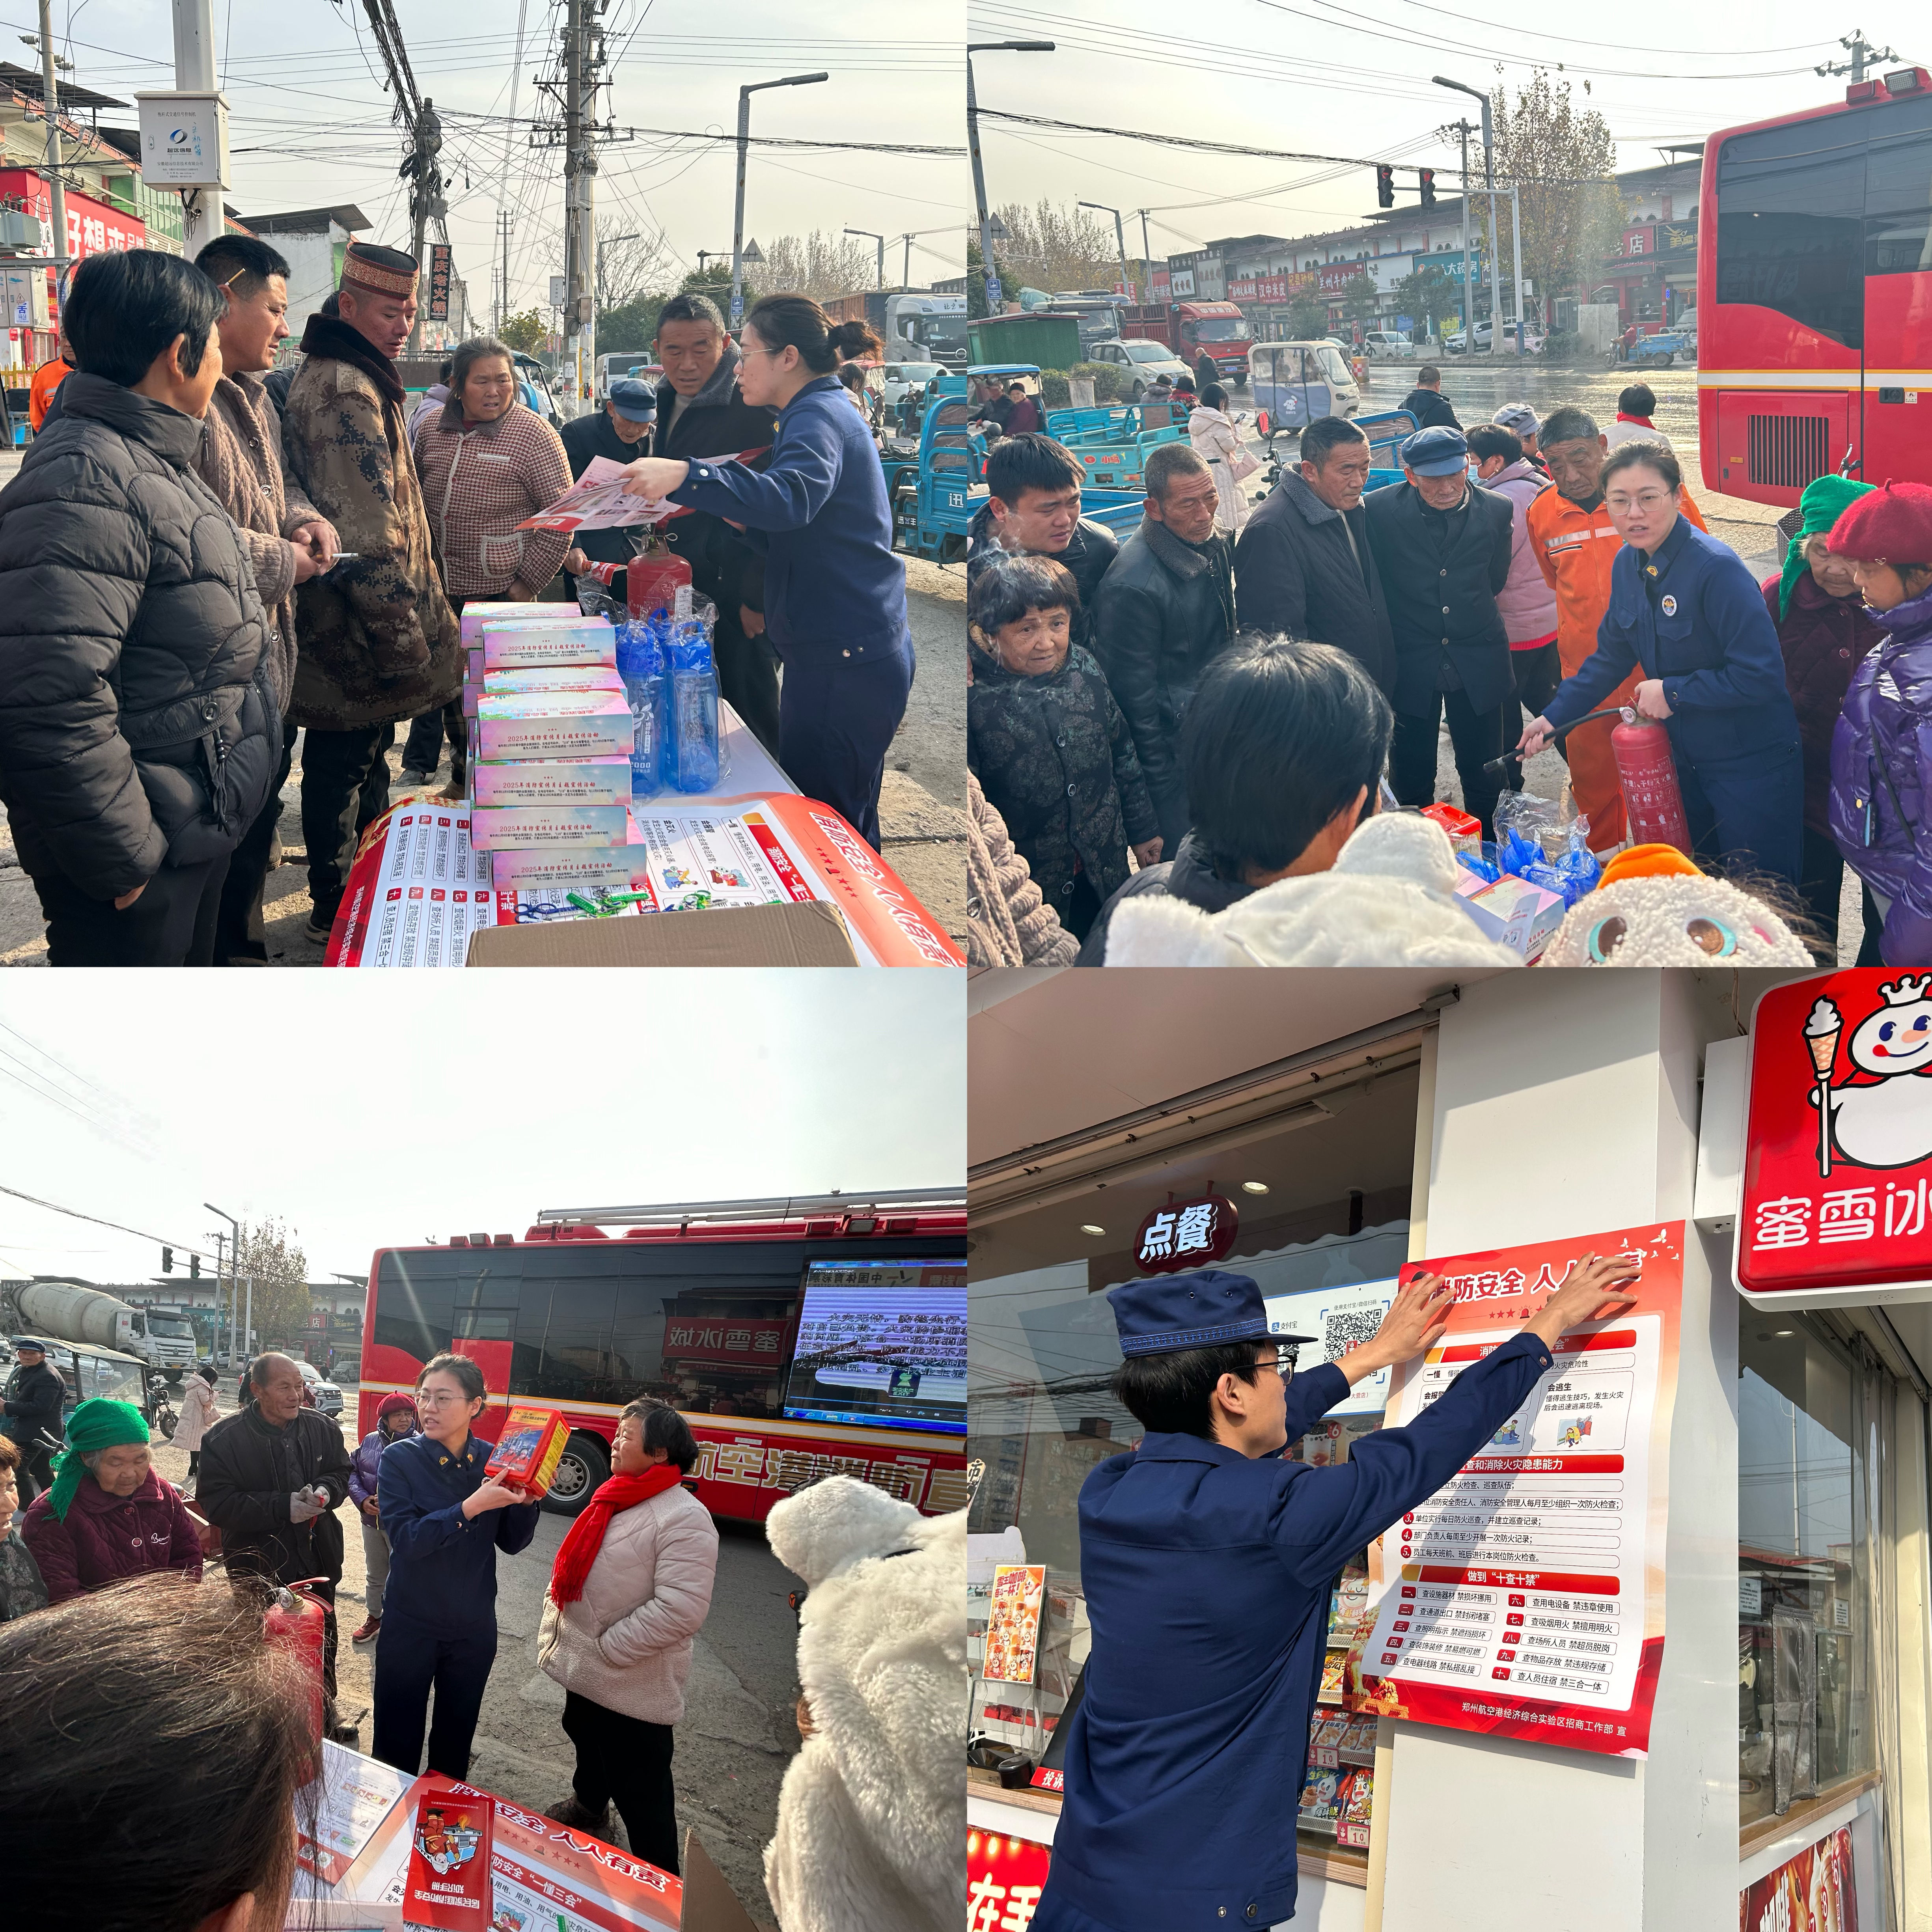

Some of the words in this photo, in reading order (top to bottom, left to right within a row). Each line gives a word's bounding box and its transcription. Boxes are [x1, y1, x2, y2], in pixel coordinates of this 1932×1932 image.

[432, 247, 449, 313] 重庆老火锅
[1259, 281, 1286, 298] 汉中米皮
[949, 492, 964, 508] 迅
[508, 733, 599, 742] 2025年消防宣传月主题宣传活动
[663, 820, 677, 834] 会灭火
[701, 820, 715, 834] 会报警
[396, 829, 409, 852] 查电器线路
[417, 828, 428, 850] 查装饰装修
[438, 830, 447, 852] 查照明指示
[458, 833, 466, 853] 查通道出口
[809, 811, 885, 880] 消防安全
[393, 852, 406, 877] 禁私搭乱接
[414, 851, 426, 875] 禁易燃可燃
[435, 852, 446, 877] 禁遮挡损坏
[456, 855, 466, 879] 禁封闭堵塞
[521, 862, 612, 873] 2025年消防宣传月主题宣传活动
[766, 846, 793, 872] 消防安全
[382, 906, 396, 936] 查人员住宿
[406, 904, 420, 934] 查物品存放
[430, 906, 441, 936] 查场所人员
[453, 908, 464, 936] 查吸烟用火
[1139, 1203, 1213, 1260] 点餐
[1333, 1299, 1377, 1311] 使用支付宝/微信扫码
[1280, 1321, 1298, 1330] 支付宝
[1427, 1370, 1441, 1378] 一懂
[1548, 1382, 1572, 1392] 会逃生
[1546, 1391, 1624, 1402] 懂得逃生技巧，发生火灾
[1544, 1402, 1605, 1412] 后会迅速逃离现场。
[1415, 1514, 1542, 1526] 单位实行每日防火巡查，并建立巡查记录；
[1414, 1531, 1533, 1544] 部门负责人每周至少开展一次防火记录；
[1413, 1548, 1539, 1562] 员工每天班前、班后进行本岗位防火检查。
[997, 1569, 1027, 1588] 雪王咖啡
[1468, 1570, 1486, 1582] 做到
[1492, 1572, 1540, 1585] “十查十禁”
[1422, 1589, 1455, 1599] 查设施器材
[1458, 1591, 1491, 1603] 禁损坏挪用
[1419, 1607, 1453, 1618] 查通道出口
[1455, 1610, 1490, 1621] 禁封闭堵塞
[1533, 1598, 1570, 1609] 查用电设备
[1573, 1601, 1613, 1613] 禁违章使用
[1414, 1624, 1449, 1635] 查照明指示
[1450, 1628, 1486, 1639] 禁遮挡损坏
[1531, 1617, 1569, 1628] 查吸烟用火
[1572, 1621, 1613, 1634] 禁擅用明火
[1408, 1640, 1443, 1652] 查装饰装修
[1445, 1645, 1481, 1656] 禁易燃可燃
[1527, 1635, 1566, 1648] 查场所人员
[1568, 1640, 1609, 1652] 禁超员脱岗
[1403, 1657, 1438, 1669] 查电器线路
[1439, 1662, 1475, 1674] 禁私搭乱接
[1522, 1653, 1562, 1666] 查物品存放
[1564, 1658, 1606, 1672] 禁违规存储
[1518, 1671, 1557, 1685] 查人员住宿
[1559, 1676, 1602, 1691] 禁三合一体
[1462, 1701, 1614, 1735] 郑州航空港经济综合实验区招商工作部
[1617, 1725, 1627, 1736] 宣
[549, 1830, 671, 1893] 人人有责
[431, 1881, 464, 1894] 知识手册
[414, 1889, 480, 1910] 居民家庭消防安全
